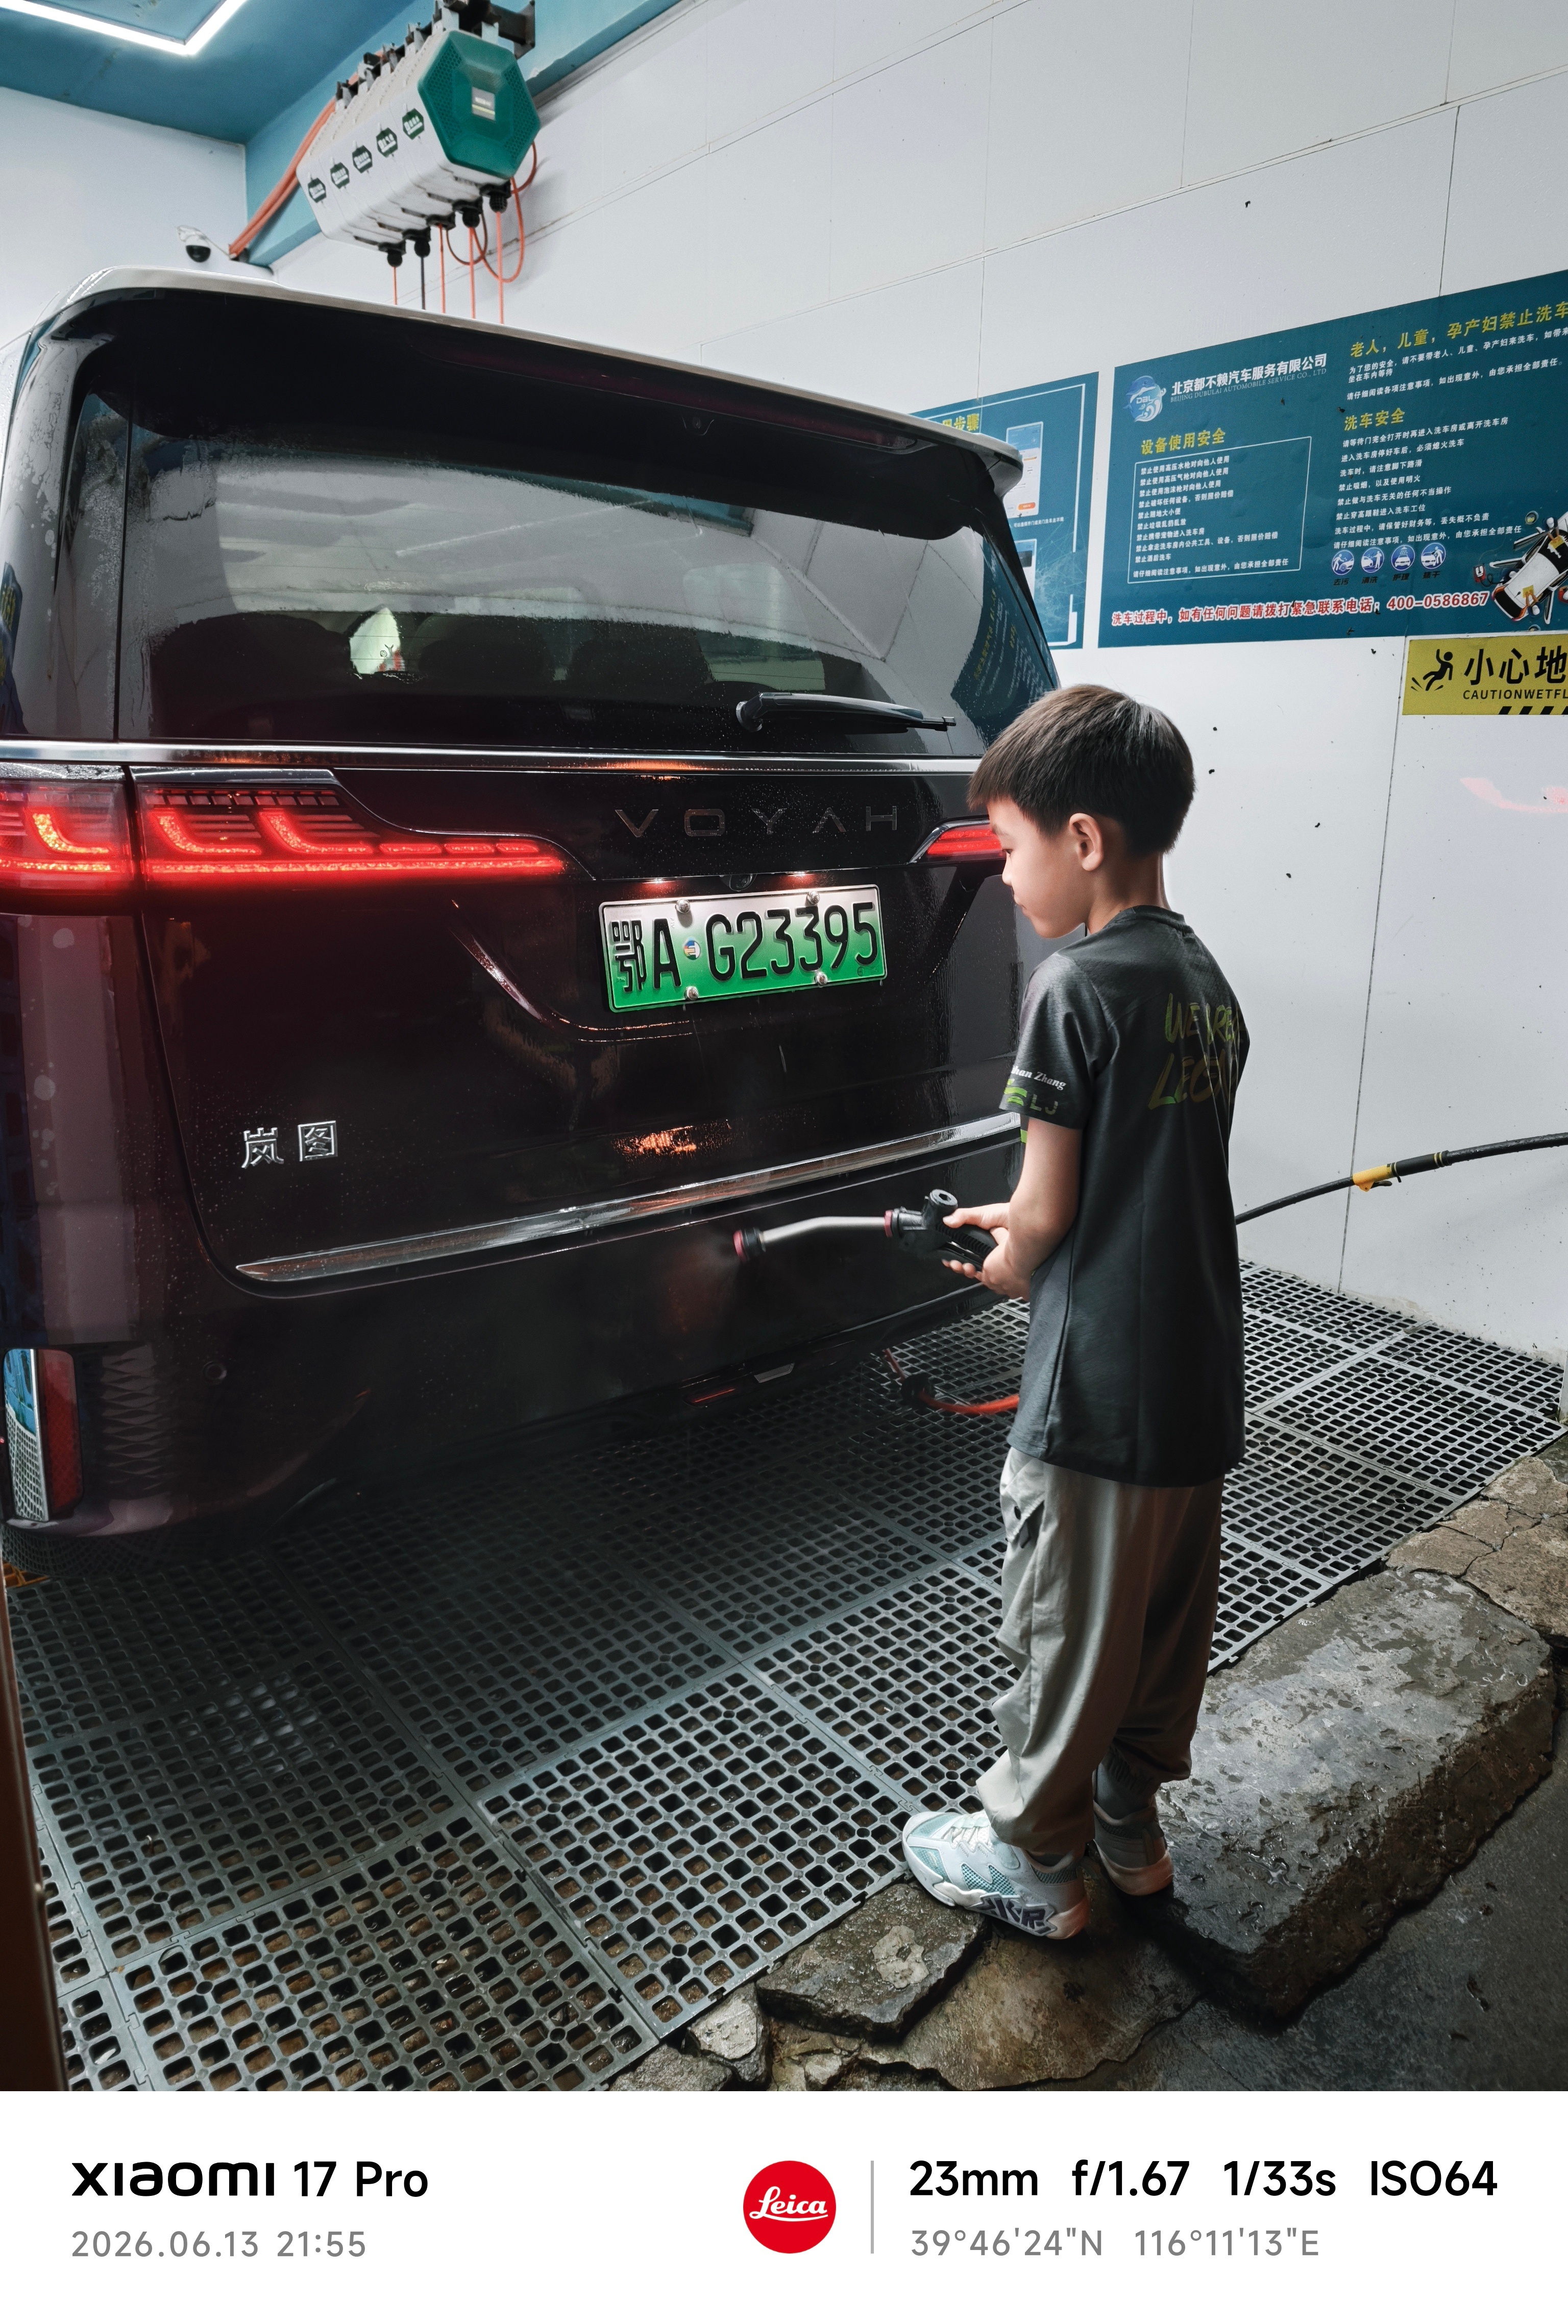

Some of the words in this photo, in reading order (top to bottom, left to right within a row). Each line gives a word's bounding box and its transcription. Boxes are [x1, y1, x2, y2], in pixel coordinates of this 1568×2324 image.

[1171, 353, 1327, 396] 北京都不赖汽车服务有限公司
[1348, 368, 1393, 383] 坐在车内等待
[1170, 393, 1193, 402] BEIJING
[1194, 388, 1222, 398] DUBULAI
[1223, 379, 1266, 393] AUTOMOBILE
[1268, 374, 1295, 384] SERVICE
[1313, 368, 1327, 376] LTD
[1344, 407, 1405, 431] 洗车安全
[1141, 428, 1226, 455] 设备使用安全
[1342, 417, 1508, 448] 请等待门完全打开时再进入洗车房或离开洗车房
[1141, 455, 1230, 475] 禁止使用高压水枪对向他人使用
[1140, 467, 1229, 487] 禁止使用高压气枪对向他人使用
[1139, 479, 1221, 497] 禁止使用泡沫枪对向他人使用
[1337, 486, 1452, 506] 禁止做与洗车无关的任何不当操作
[1138, 507, 1181, 520] 禁止随地大小便
[1336, 504, 1426, 521] 禁止穿高跟鞋进入洗车工位
[1137, 518, 1187, 530] 禁止垃圾乱扔乱放
[1136, 527, 1205, 542] 禁止携带宠物进入洗车房
[1135, 553, 1171, 563] 禁止酒后洗车
[1464, 645, 1567, 685] 小心地
[615, 806, 897, 837] VOYAH
[1034, 1072, 1067, 1091] Zhang
[241, 1120, 338, 1169] 岚图
